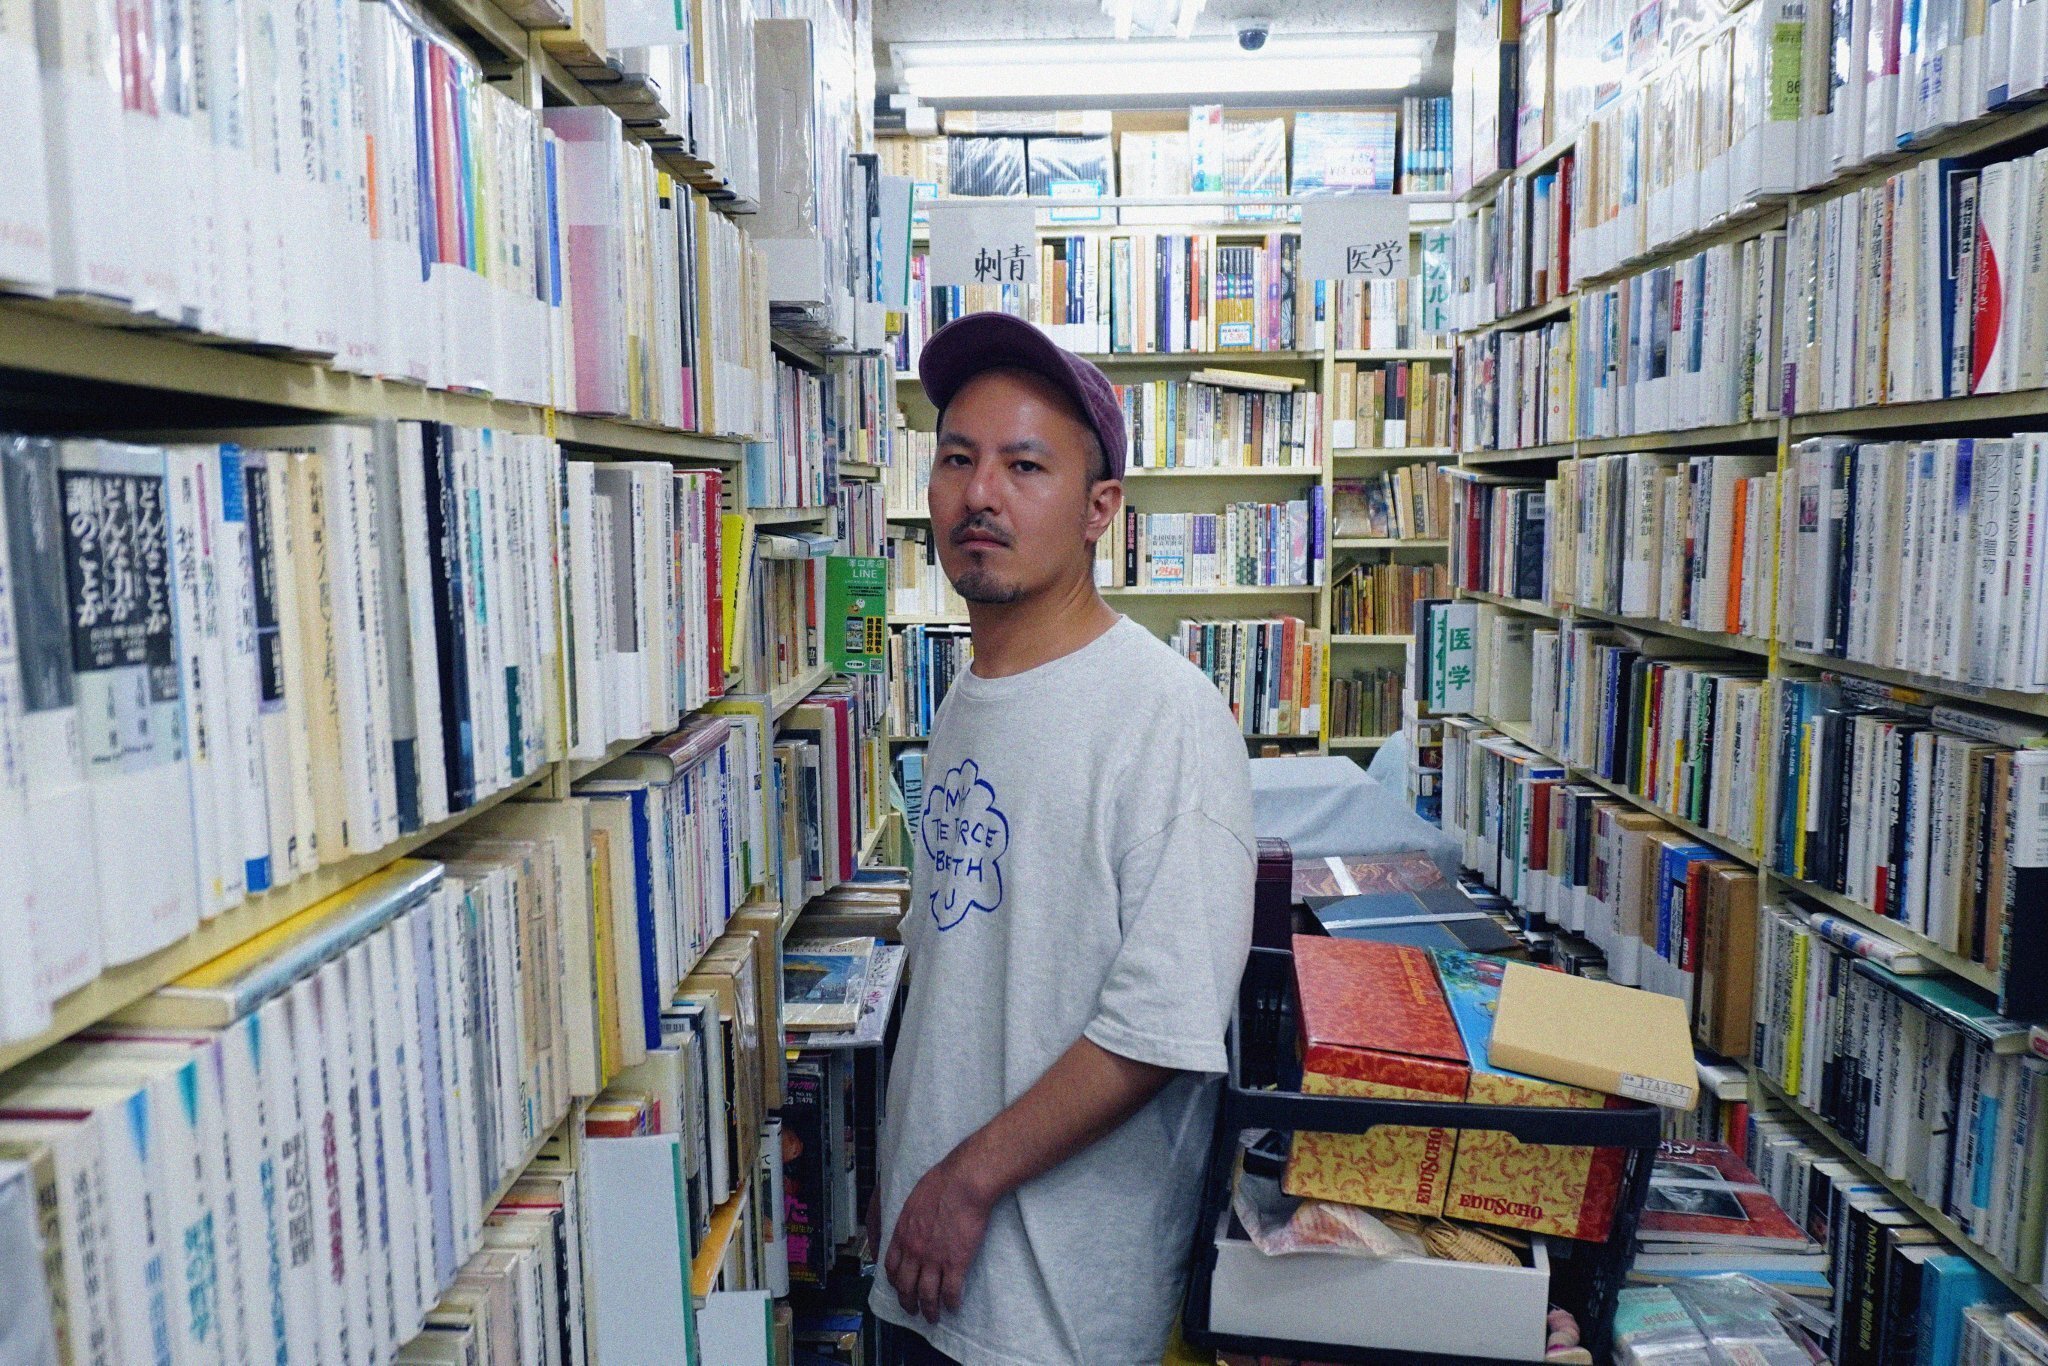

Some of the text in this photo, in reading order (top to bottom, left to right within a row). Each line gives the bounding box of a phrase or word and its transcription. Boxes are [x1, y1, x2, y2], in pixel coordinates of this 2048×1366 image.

[974, 243, 1031, 283] 刺青
[1347, 239, 1402, 277] 医学
[852, 569, 878, 579] LINE
[1448, 627, 1472, 691] 医学
[935, 850, 984, 883] BETH
[1416, 1127, 1443, 1205] EDUSCHO
[1458, 1193, 1543, 1220] EDUSCHO
